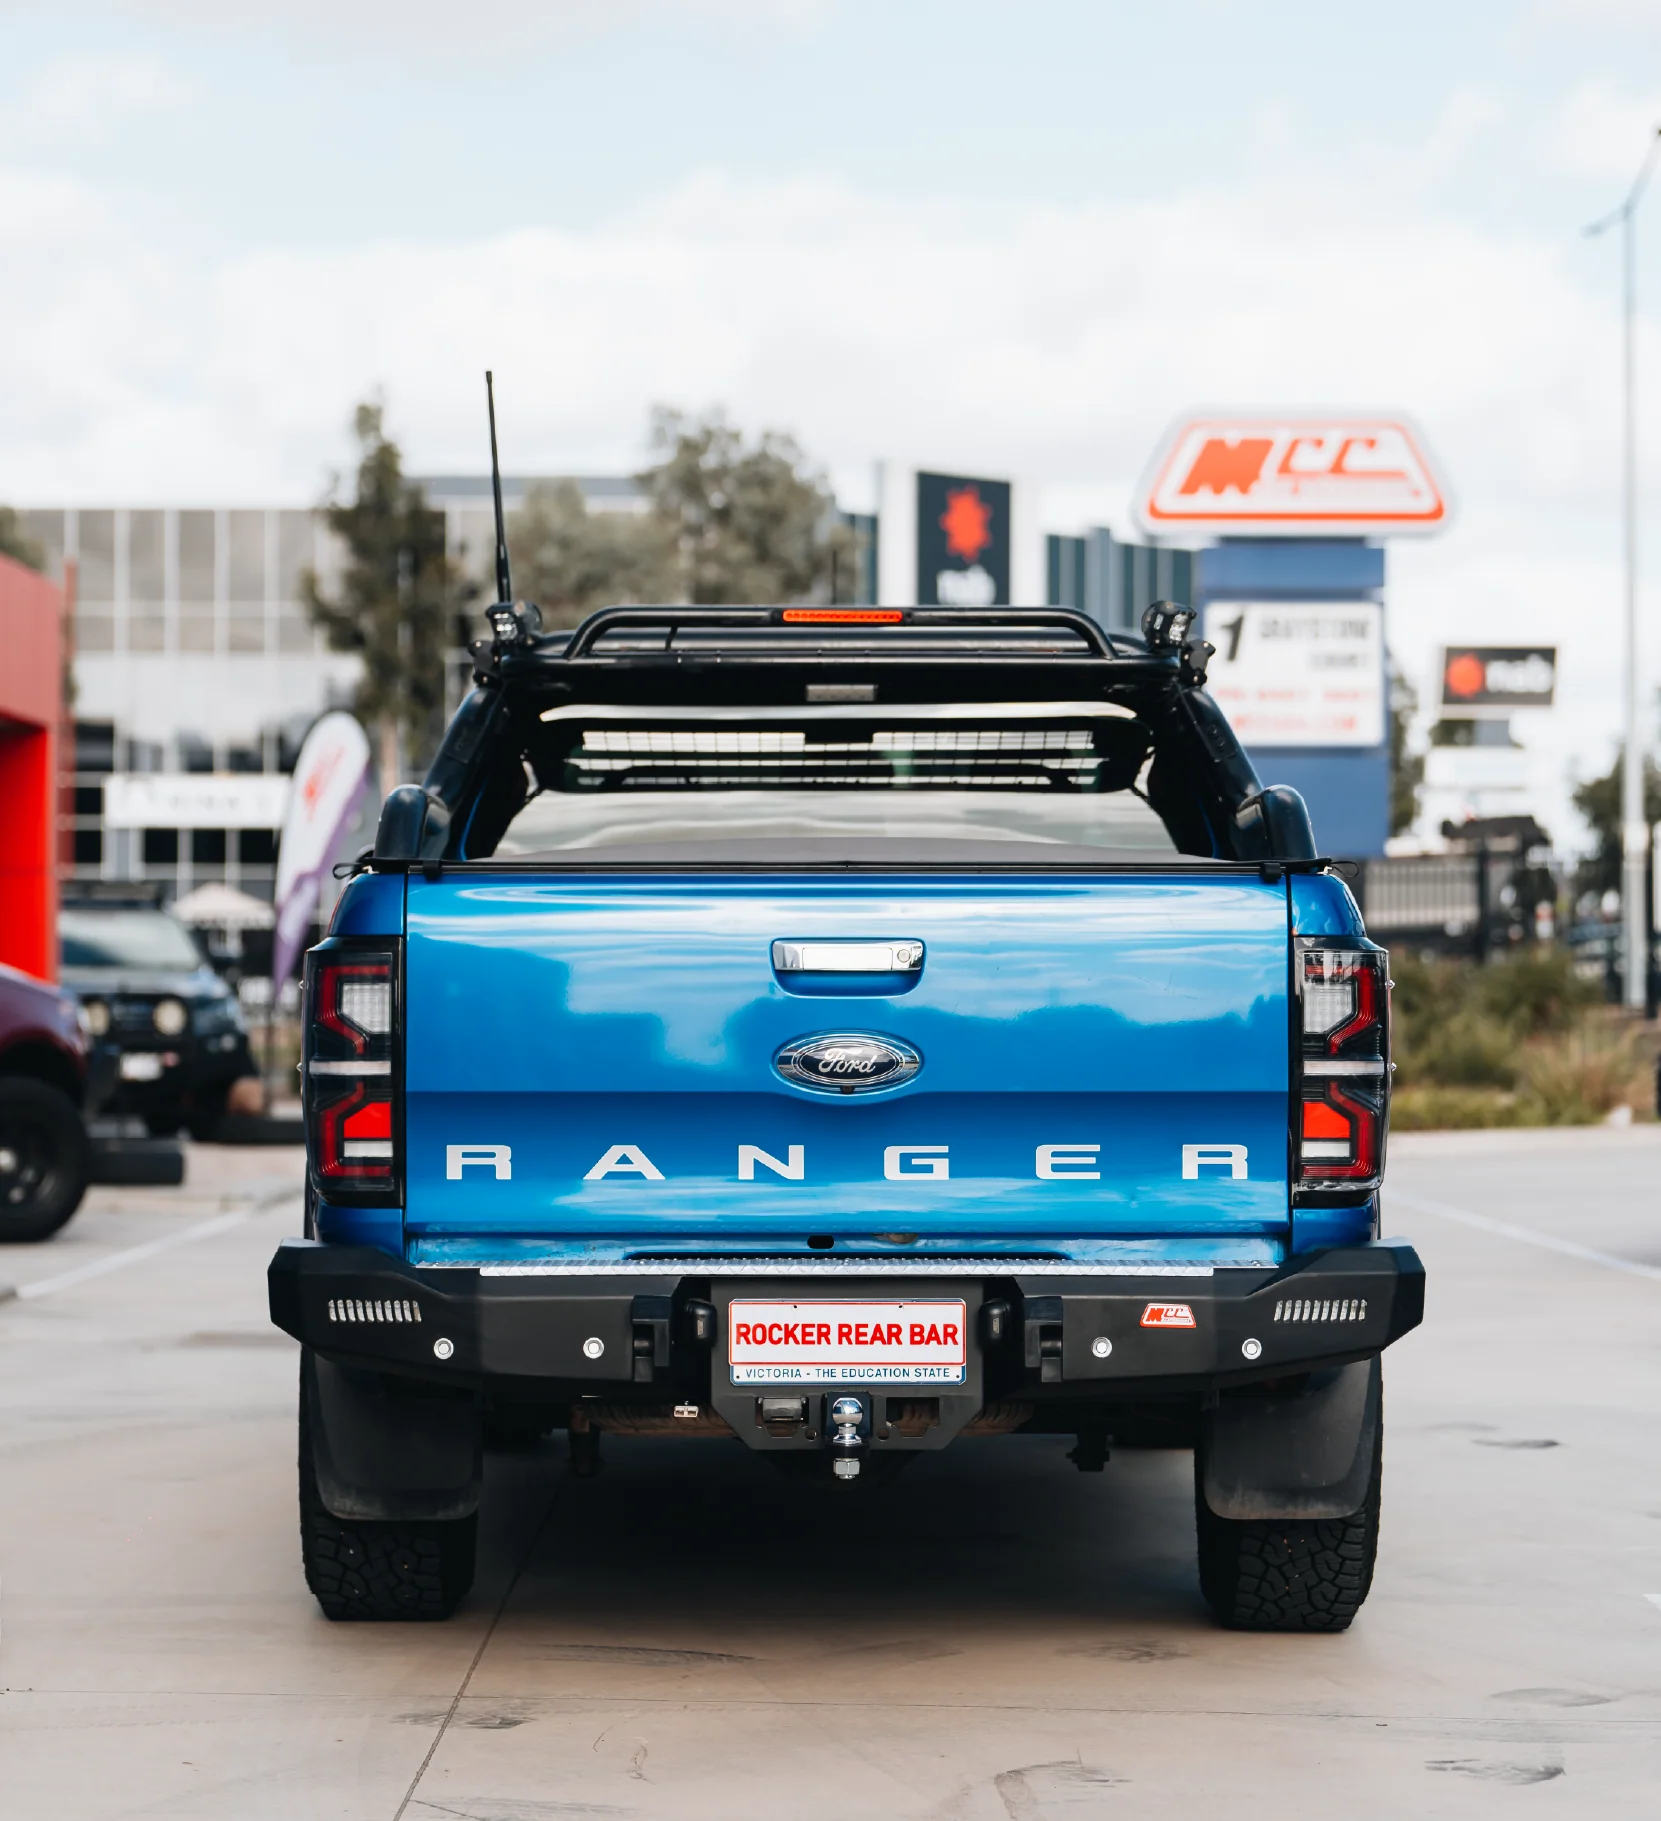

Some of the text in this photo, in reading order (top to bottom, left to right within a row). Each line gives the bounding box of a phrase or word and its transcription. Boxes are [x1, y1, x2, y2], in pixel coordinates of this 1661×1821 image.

[1220, 613, 1245, 662] 1
[818, 1047, 876, 1073] Ford
[446, 1144, 1248, 1181] RANGER
[735, 1323, 959, 1345] ROCKER REAR BAR
[745, 1368, 802, 1379] VICTORIA
[815, 1368, 837, 1379] THE
[841, 1367, 910, 1378] EDUCATION
[914, 1367, 950, 1378] STATE
